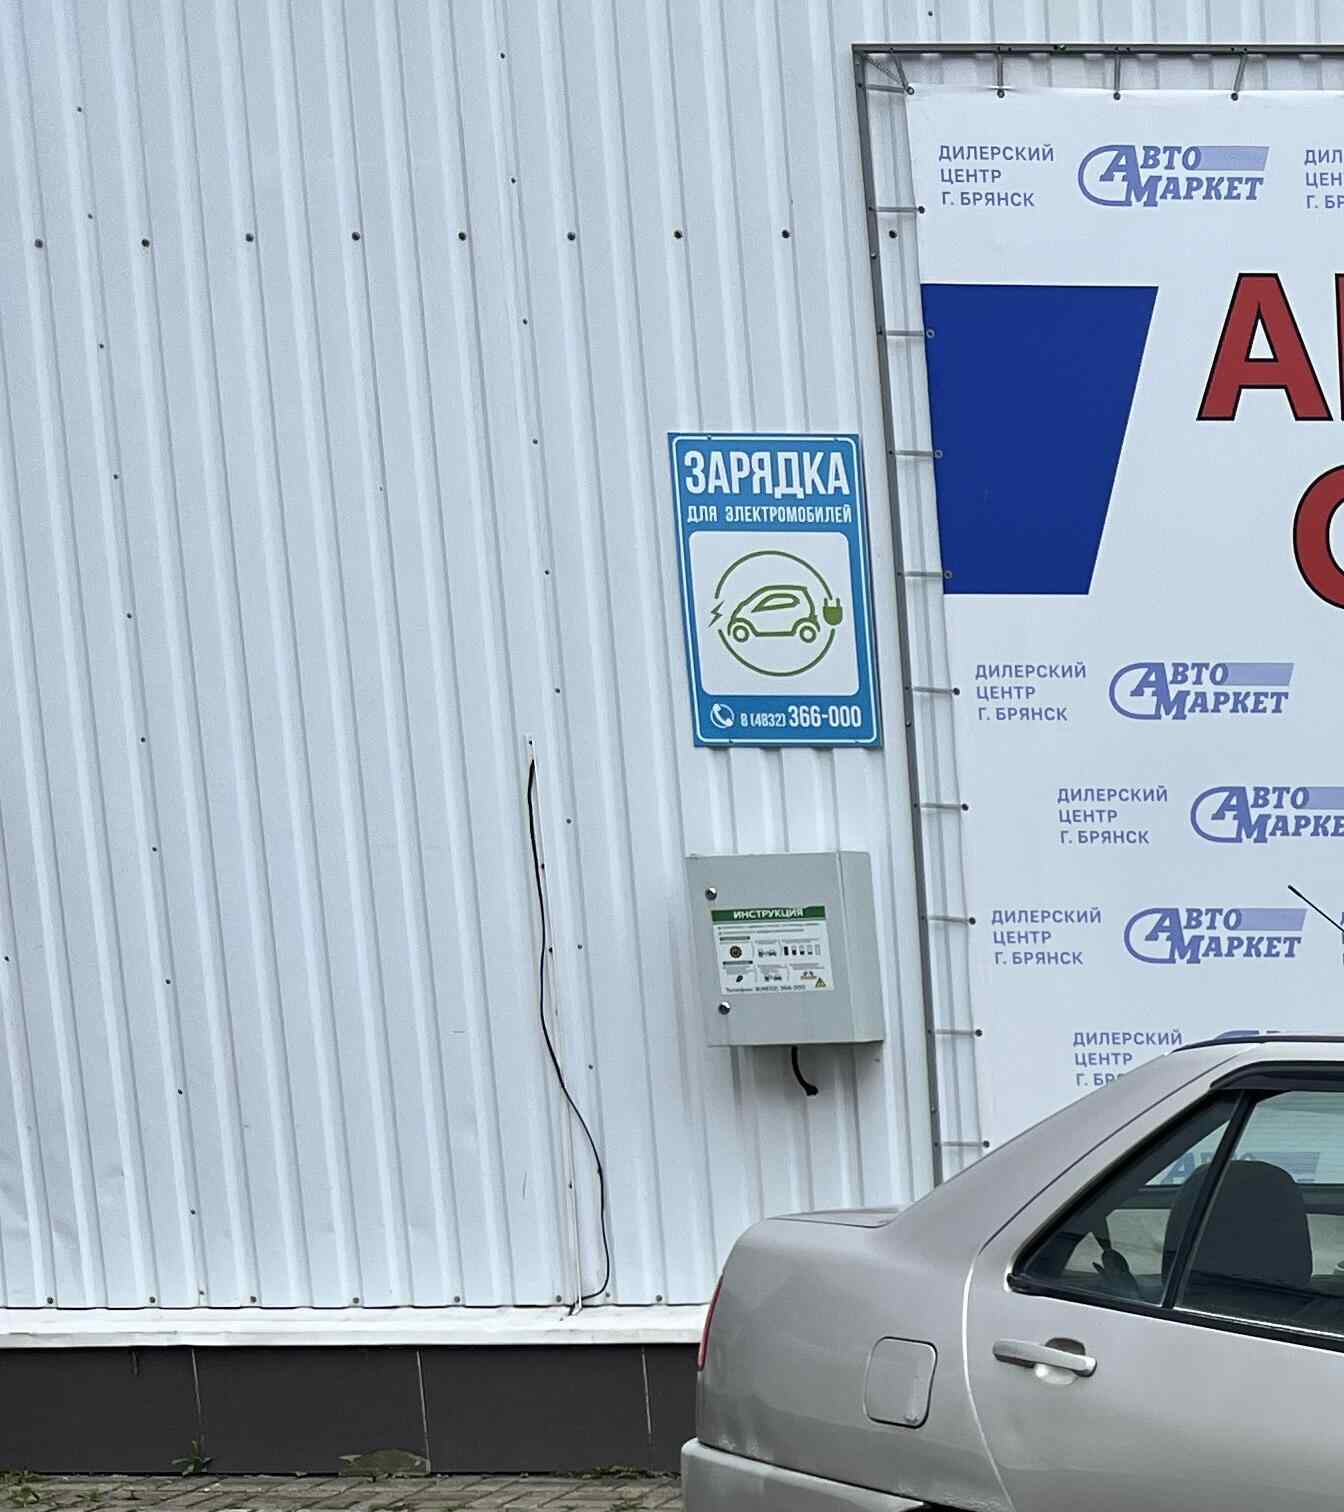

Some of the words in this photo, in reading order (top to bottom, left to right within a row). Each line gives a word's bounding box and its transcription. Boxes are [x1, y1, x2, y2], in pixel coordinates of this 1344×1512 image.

[939, 144, 1053, 162] ДИЛЕРСКИЙ
[941, 168, 1001, 184] ЦЕНТР
[942, 192, 954, 205] Г.
[960, 192, 1034, 207] БРЯНСК
[1307, 195, 1318, 208] Г.
[684, 450, 850, 499] ЗАРЯДКА
[687, 505, 718, 524] ДЛЯ
[725, 503, 852, 523] ЭЛЕКТРОМОБИЛЕЙ
[975, 662, 1086, 680] ДИЛЕРСКИЙ
[976, 686, 1035, 701] ЦЕНТР
[740, 713, 748, 727] 8
[750, 713, 786, 727] (4832)
[788, 705, 861, 727] 366-000
[978, 707, 990, 720] Г.
[996, 707, 1067, 721] БРЯНСК
[1057, 785, 1167, 804] ДИЛЕРСКИЙ
[1059, 809, 1117, 824] ЦЕНТР
[1061, 830, 1072, 844] Г.
[1078, 830, 1149, 844] БРЯНСК
[733, 908, 804, 920] ИНСТРУКЦИЯ
[992, 907, 1101, 925] ДИЛЕРСКИЙ
[993, 931, 1051, 946] ЦЕНТР
[995, 952, 1006, 964] Г.
[1012, 952, 1083, 965] БРЯНСК
[1073, 1029, 1182, 1047] ДИЛЕРСКИЙ
[1075, 1053, 1133, 1067] ЦЕНТР
[1076, 1073, 1088, 1086] Г.
